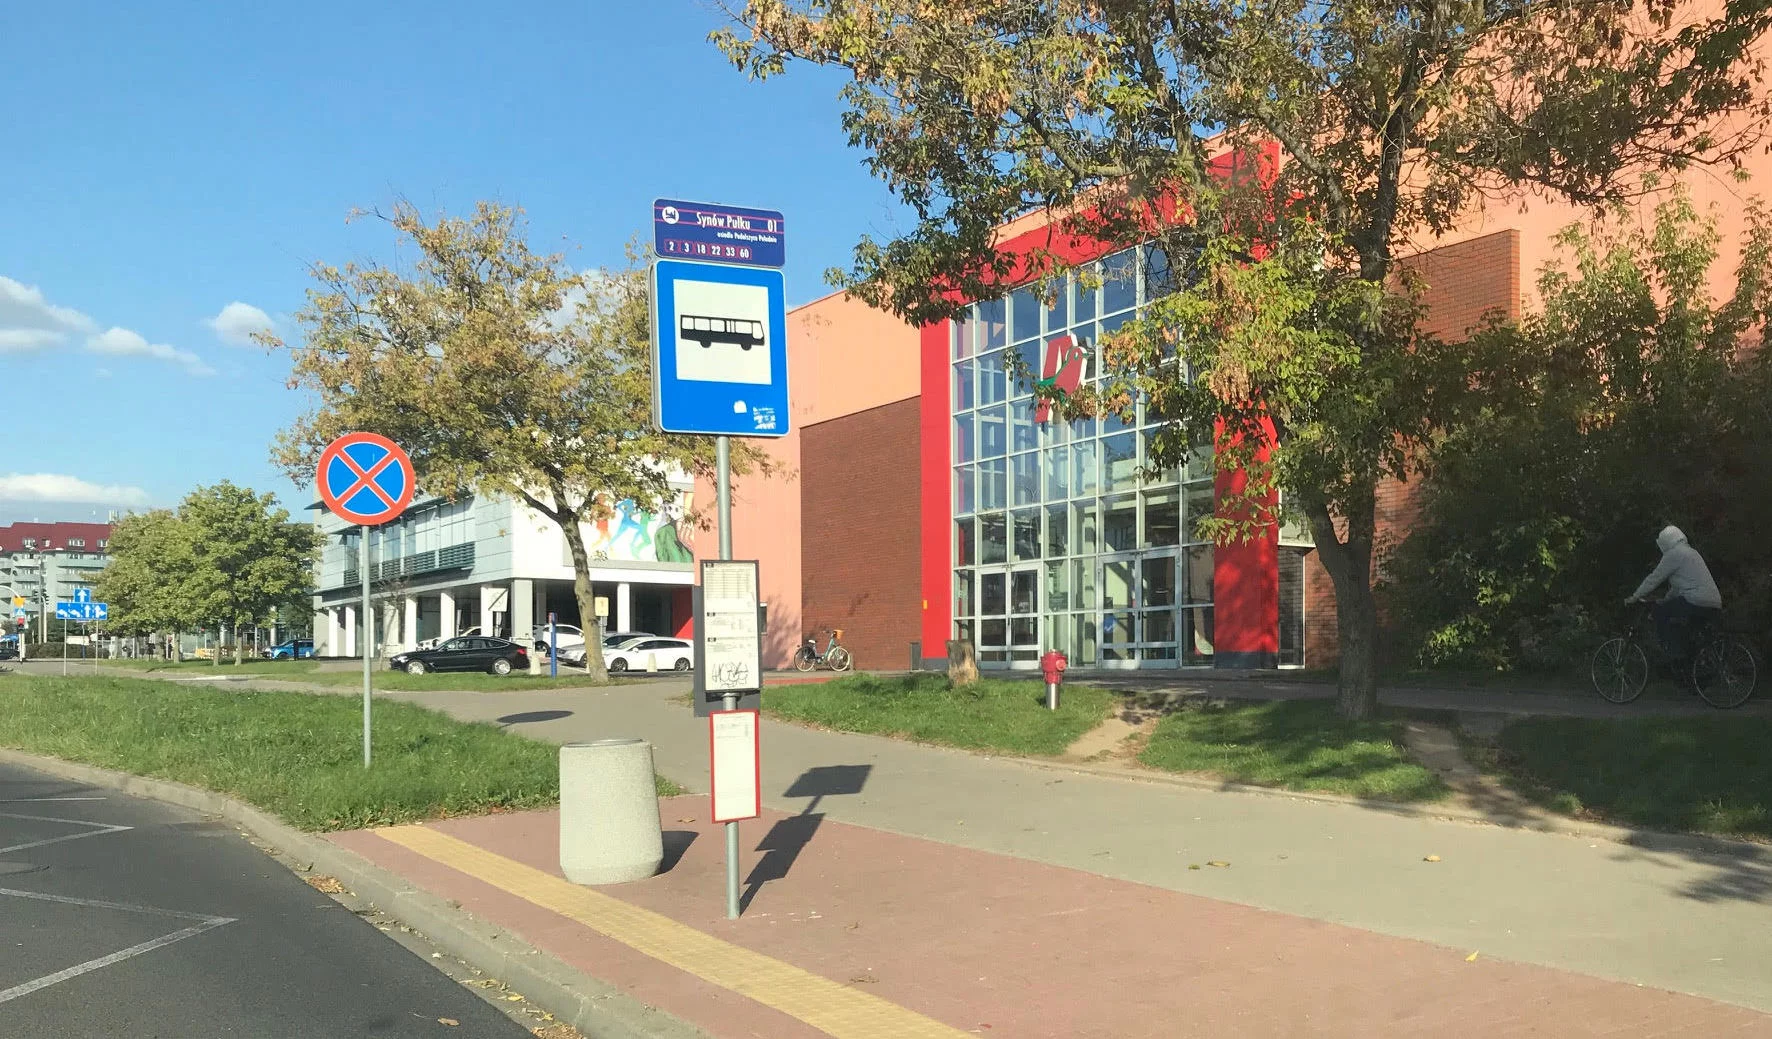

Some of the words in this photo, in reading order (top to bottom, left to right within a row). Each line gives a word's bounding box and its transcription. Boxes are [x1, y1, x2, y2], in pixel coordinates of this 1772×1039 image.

[696, 212, 725, 229] Synów
[767, 219, 777, 233] 01
[669, 241, 674, 251] 2
[684, 243, 690, 253] 3
[697, 244, 706, 254] 18
[711, 245, 721, 255] 22
[726, 247, 736, 257] 33
[739, 248, 750, 258] 60
